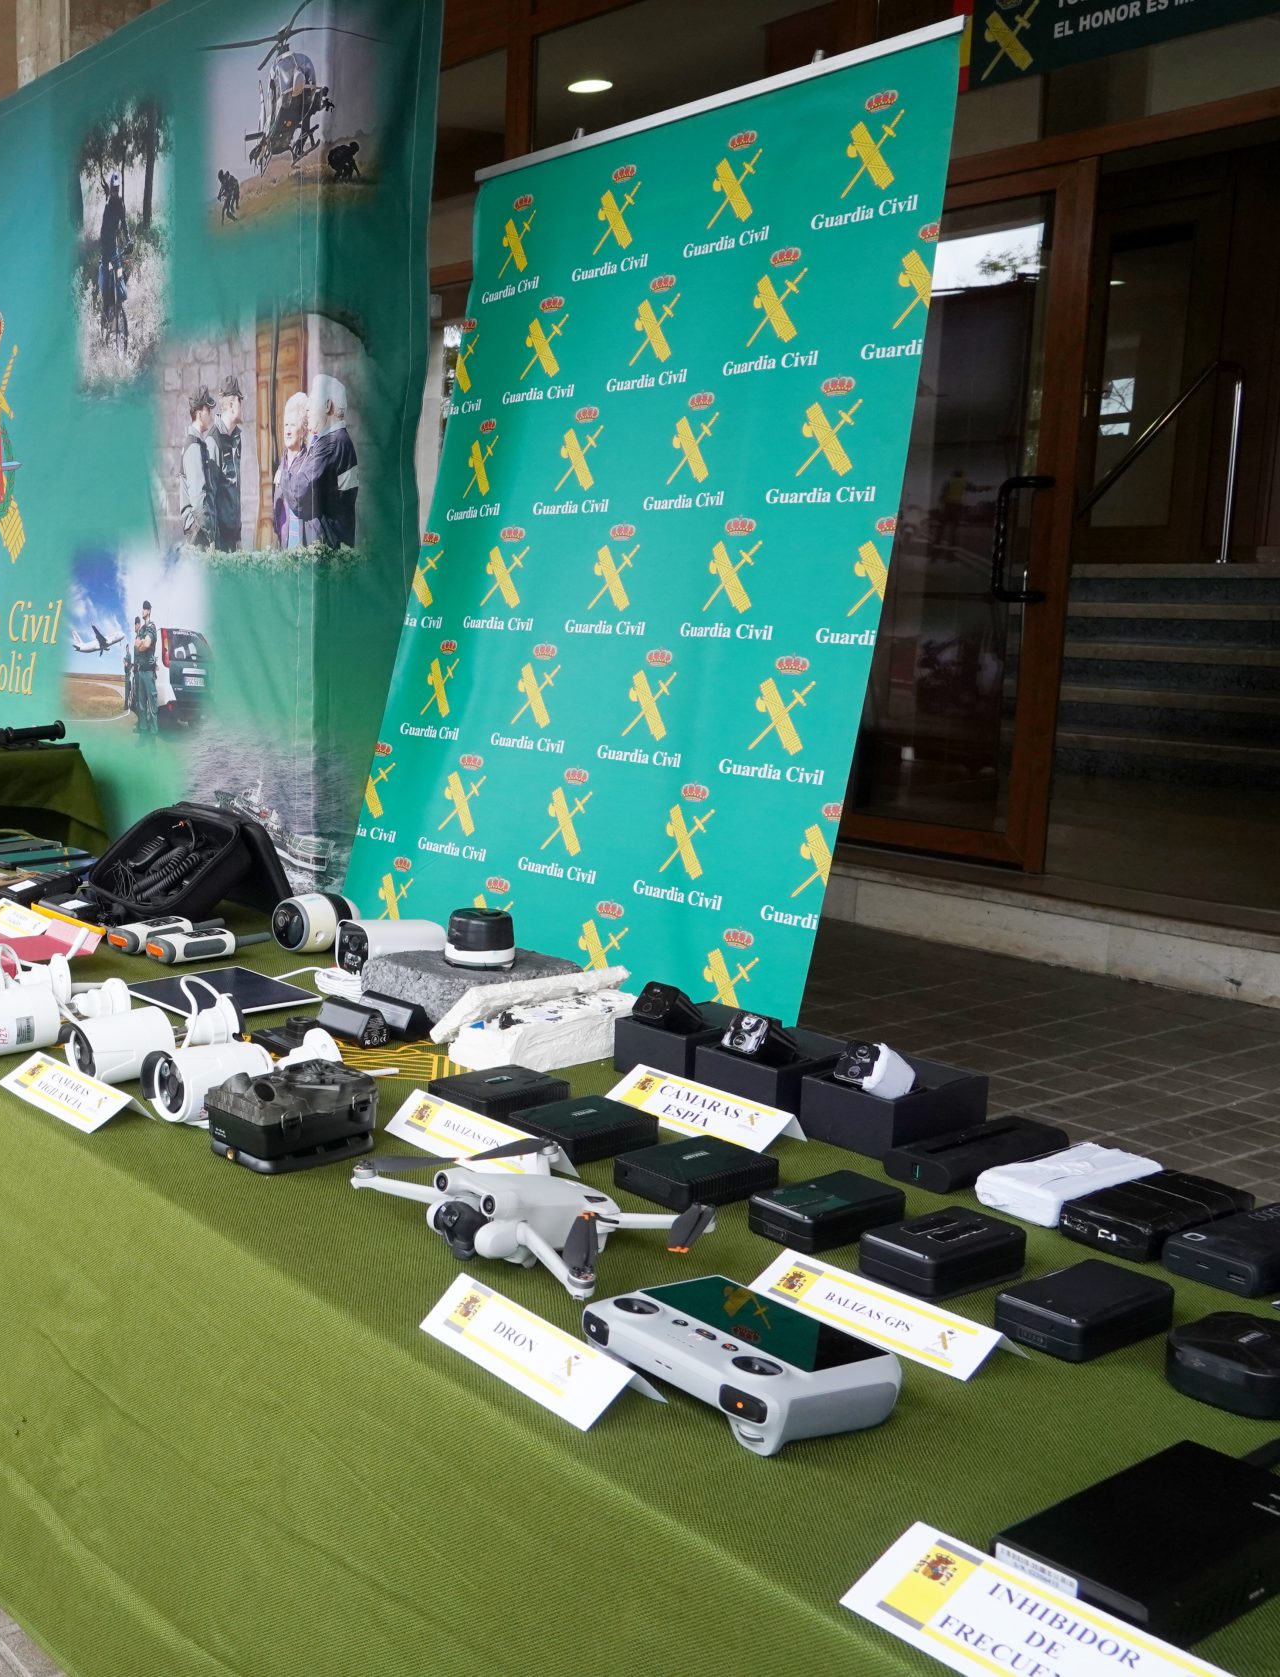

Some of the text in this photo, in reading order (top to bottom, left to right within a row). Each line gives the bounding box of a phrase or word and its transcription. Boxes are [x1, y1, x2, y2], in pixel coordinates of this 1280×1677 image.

[1053, 20, 1074, 39] EL
[1078, 2, 1141, 32] HONOR
[1146, 0, 1170, 14] ES
[811, 195, 918, 229] Guardia Civil
[683, 226, 769, 257] Guardia Civil
[572, 254, 647, 281] Guardia Civil
[482, 277, 539, 304] Guardia Civil
[723, 352, 818, 375] Guardia Civil
[606, 369, 687, 392] Guardia Civil
[503, 384, 574, 403] Guardia Civil
[461, 399, 482, 413] Civil
[643, 492, 723, 510] Guardia Civil
[766, 486, 875, 503] Guardia Civil
[447, 504, 499, 520] Guardia Civil
[533, 499, 608, 515] Guardia Civil
[8, 598, 62, 645] Civil
[420, 616, 443, 629] Civil
[464, 617, 533, 631] Guardia Civil
[565, 620, 645, 635] Guardia Civil
[680, 623, 772, 640] Guardia Civil
[400, 724, 458, 739] Guardia Civil
[491, 733, 564, 752] Guardia Civil
[597, 745, 680, 767] Guardia Civil
[719, 759, 824, 784] Guardia Civil
[370, 828, 396, 842] Civil
[418, 838, 486, 861] Guardia Civil
[518, 858, 596, 884] Guardia Civil
[633, 880, 722, 910] Guardia Civil
[658, 1082, 741, 1121] CÁMARAS
[662, 1104, 709, 1131] ESPÍA
[443, 1119, 482, 1143] BALIZAS
[825, 1292, 914, 1334] BALIZAS GPS
[493, 1320, 540, 1354] DRON
[988, 1582, 1141, 1669] INHIBIDOR
[937, 1614, 1060, 1677] FRECUE
[1024, 1630, 1066, 1660] DE
